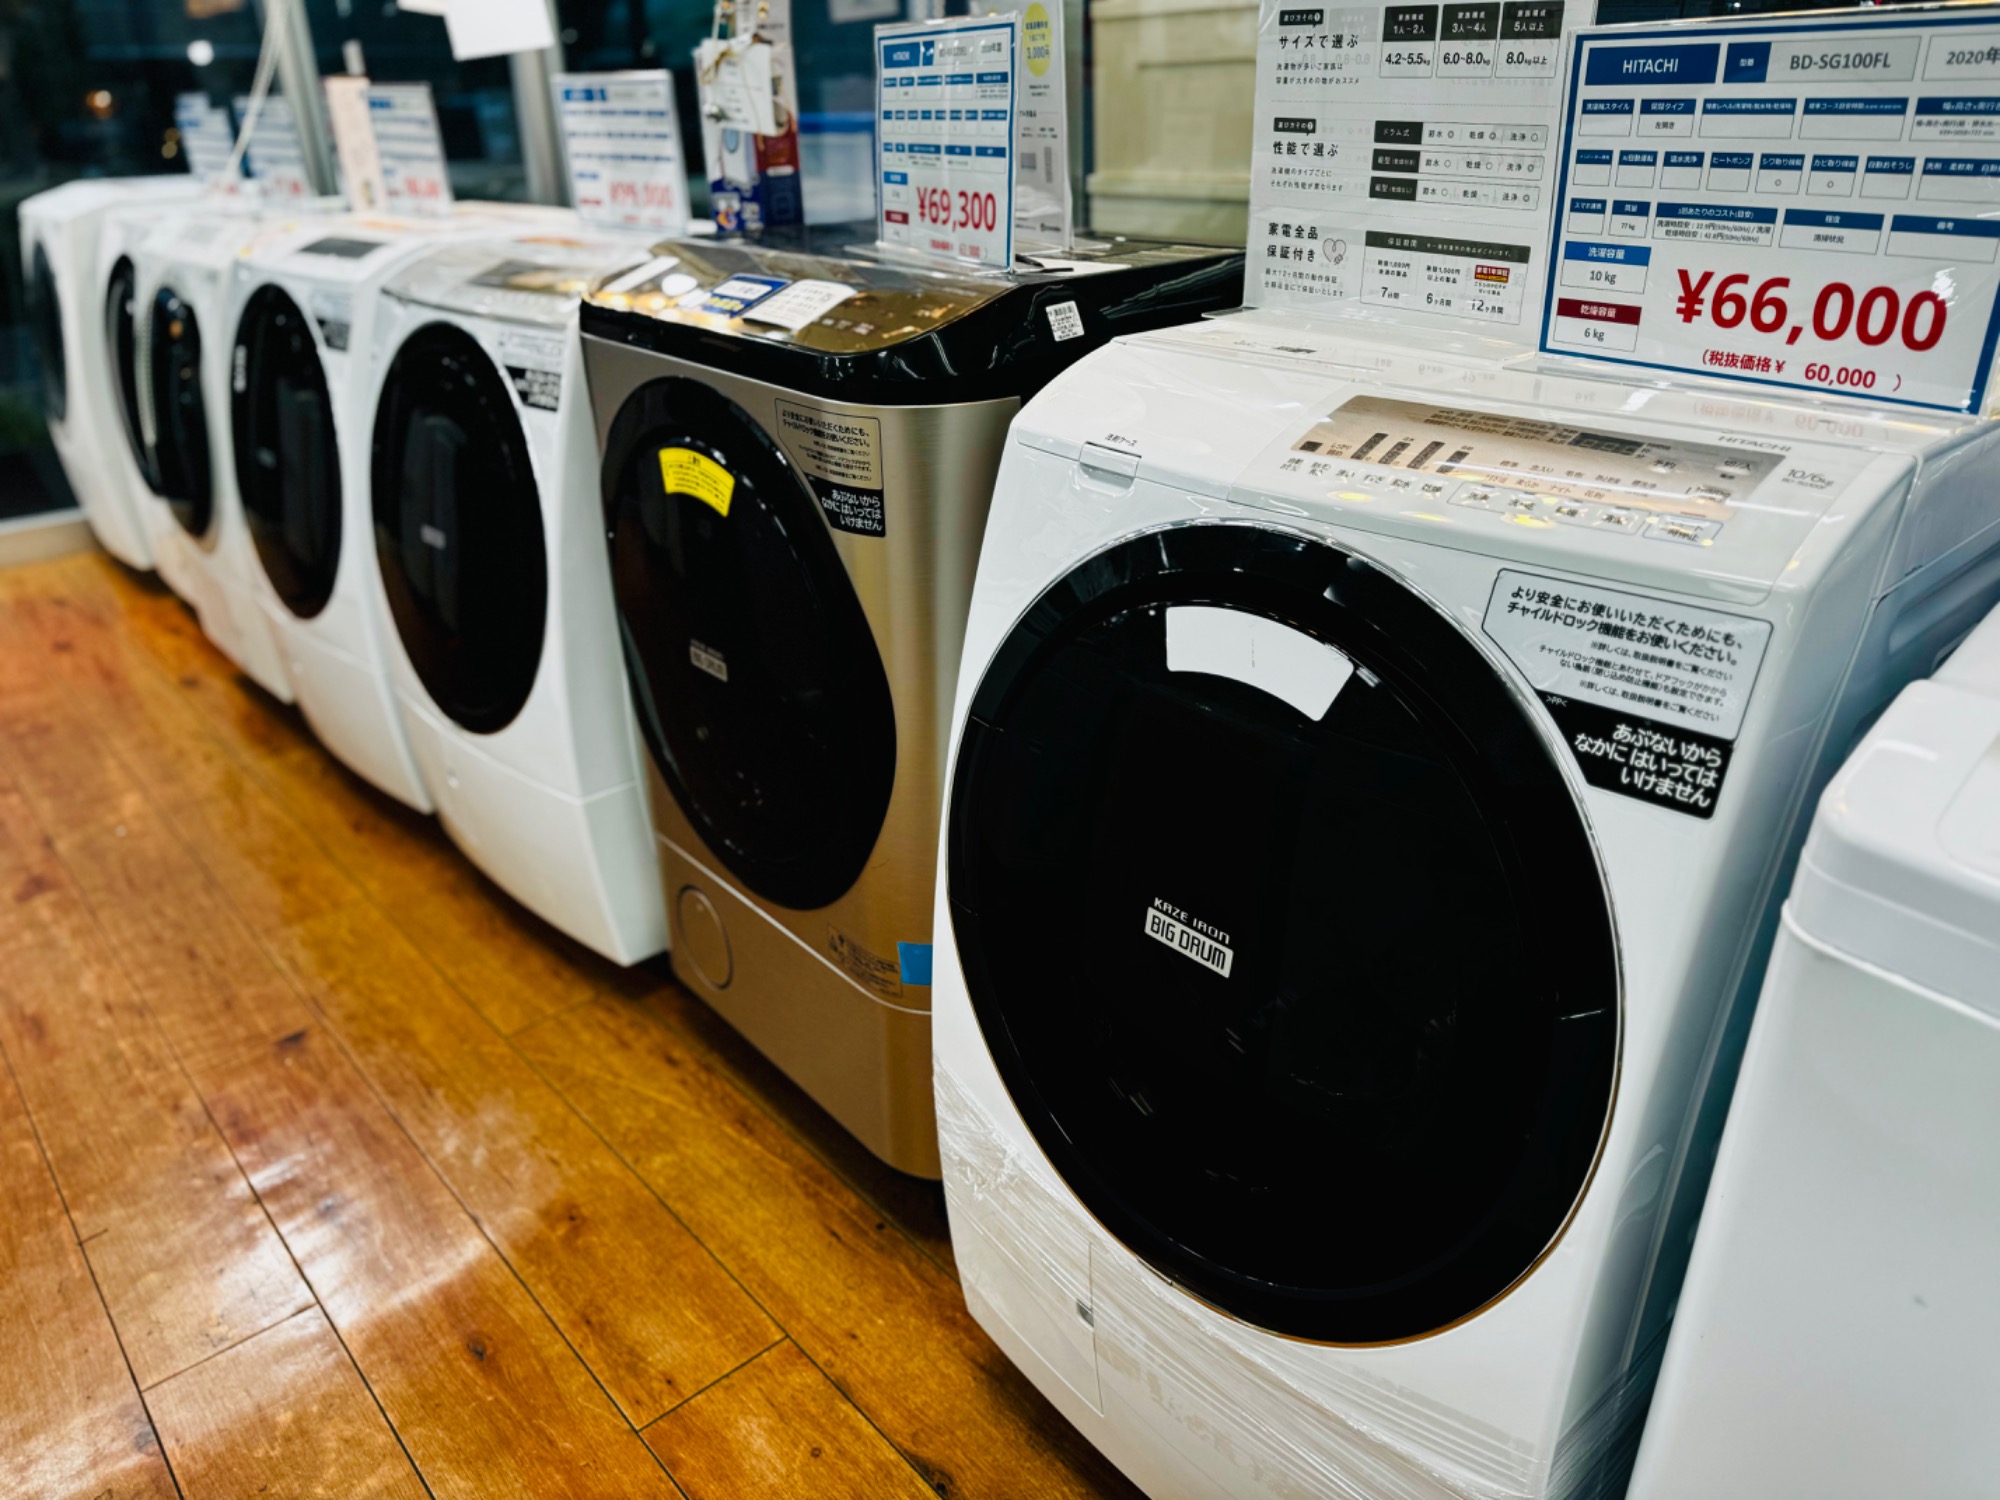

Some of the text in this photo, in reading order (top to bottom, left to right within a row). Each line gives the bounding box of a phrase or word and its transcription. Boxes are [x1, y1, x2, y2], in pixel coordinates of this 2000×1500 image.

[1513, 20, 1545, 32] 5人以上
[1278, 33, 1360, 49] サイズで選ぶ
[1622, 57, 1679, 74] HITACHI
[1789, 52, 1891, 70] BD-SG100FL
[1273, 140, 1339, 157] 性能で選ぶ
[917, 186, 997, 232] ¥69,300
[1268, 222, 1319, 240] 家電全品
[1266, 244, 1316, 263] 保証付き
[1588, 246, 1626, 260] 洗濯容量
[1589, 270, 1617, 285] 10 kg
[1381, 286, 1400, 300] 7日間
[1579, 303, 1618, 318] 乾燥容量
[1676, 268, 1948, 352] ¥66,000
[1583, 327, 1605, 343] 6 kg
[1804, 362, 1876, 389] 60,000
[1717, 435, 1793, 452] HITACHI
[1786, 467, 1835, 488] 10/6kg
[832, 488, 881, 508] あぶないから
[840, 514, 882, 531] いけません
[1511, 586, 1742, 650] より安全にお使いいただくためにも、
[1507, 601, 1737, 666] チャイルドロック機能をお使いください。
[1611, 723, 1723, 768] あぶないから
[1574, 732, 1718, 788] なかに はいっては
[1620, 767, 1712, 809] いけません
[1150, 914, 1227, 971] BIG DRUM
